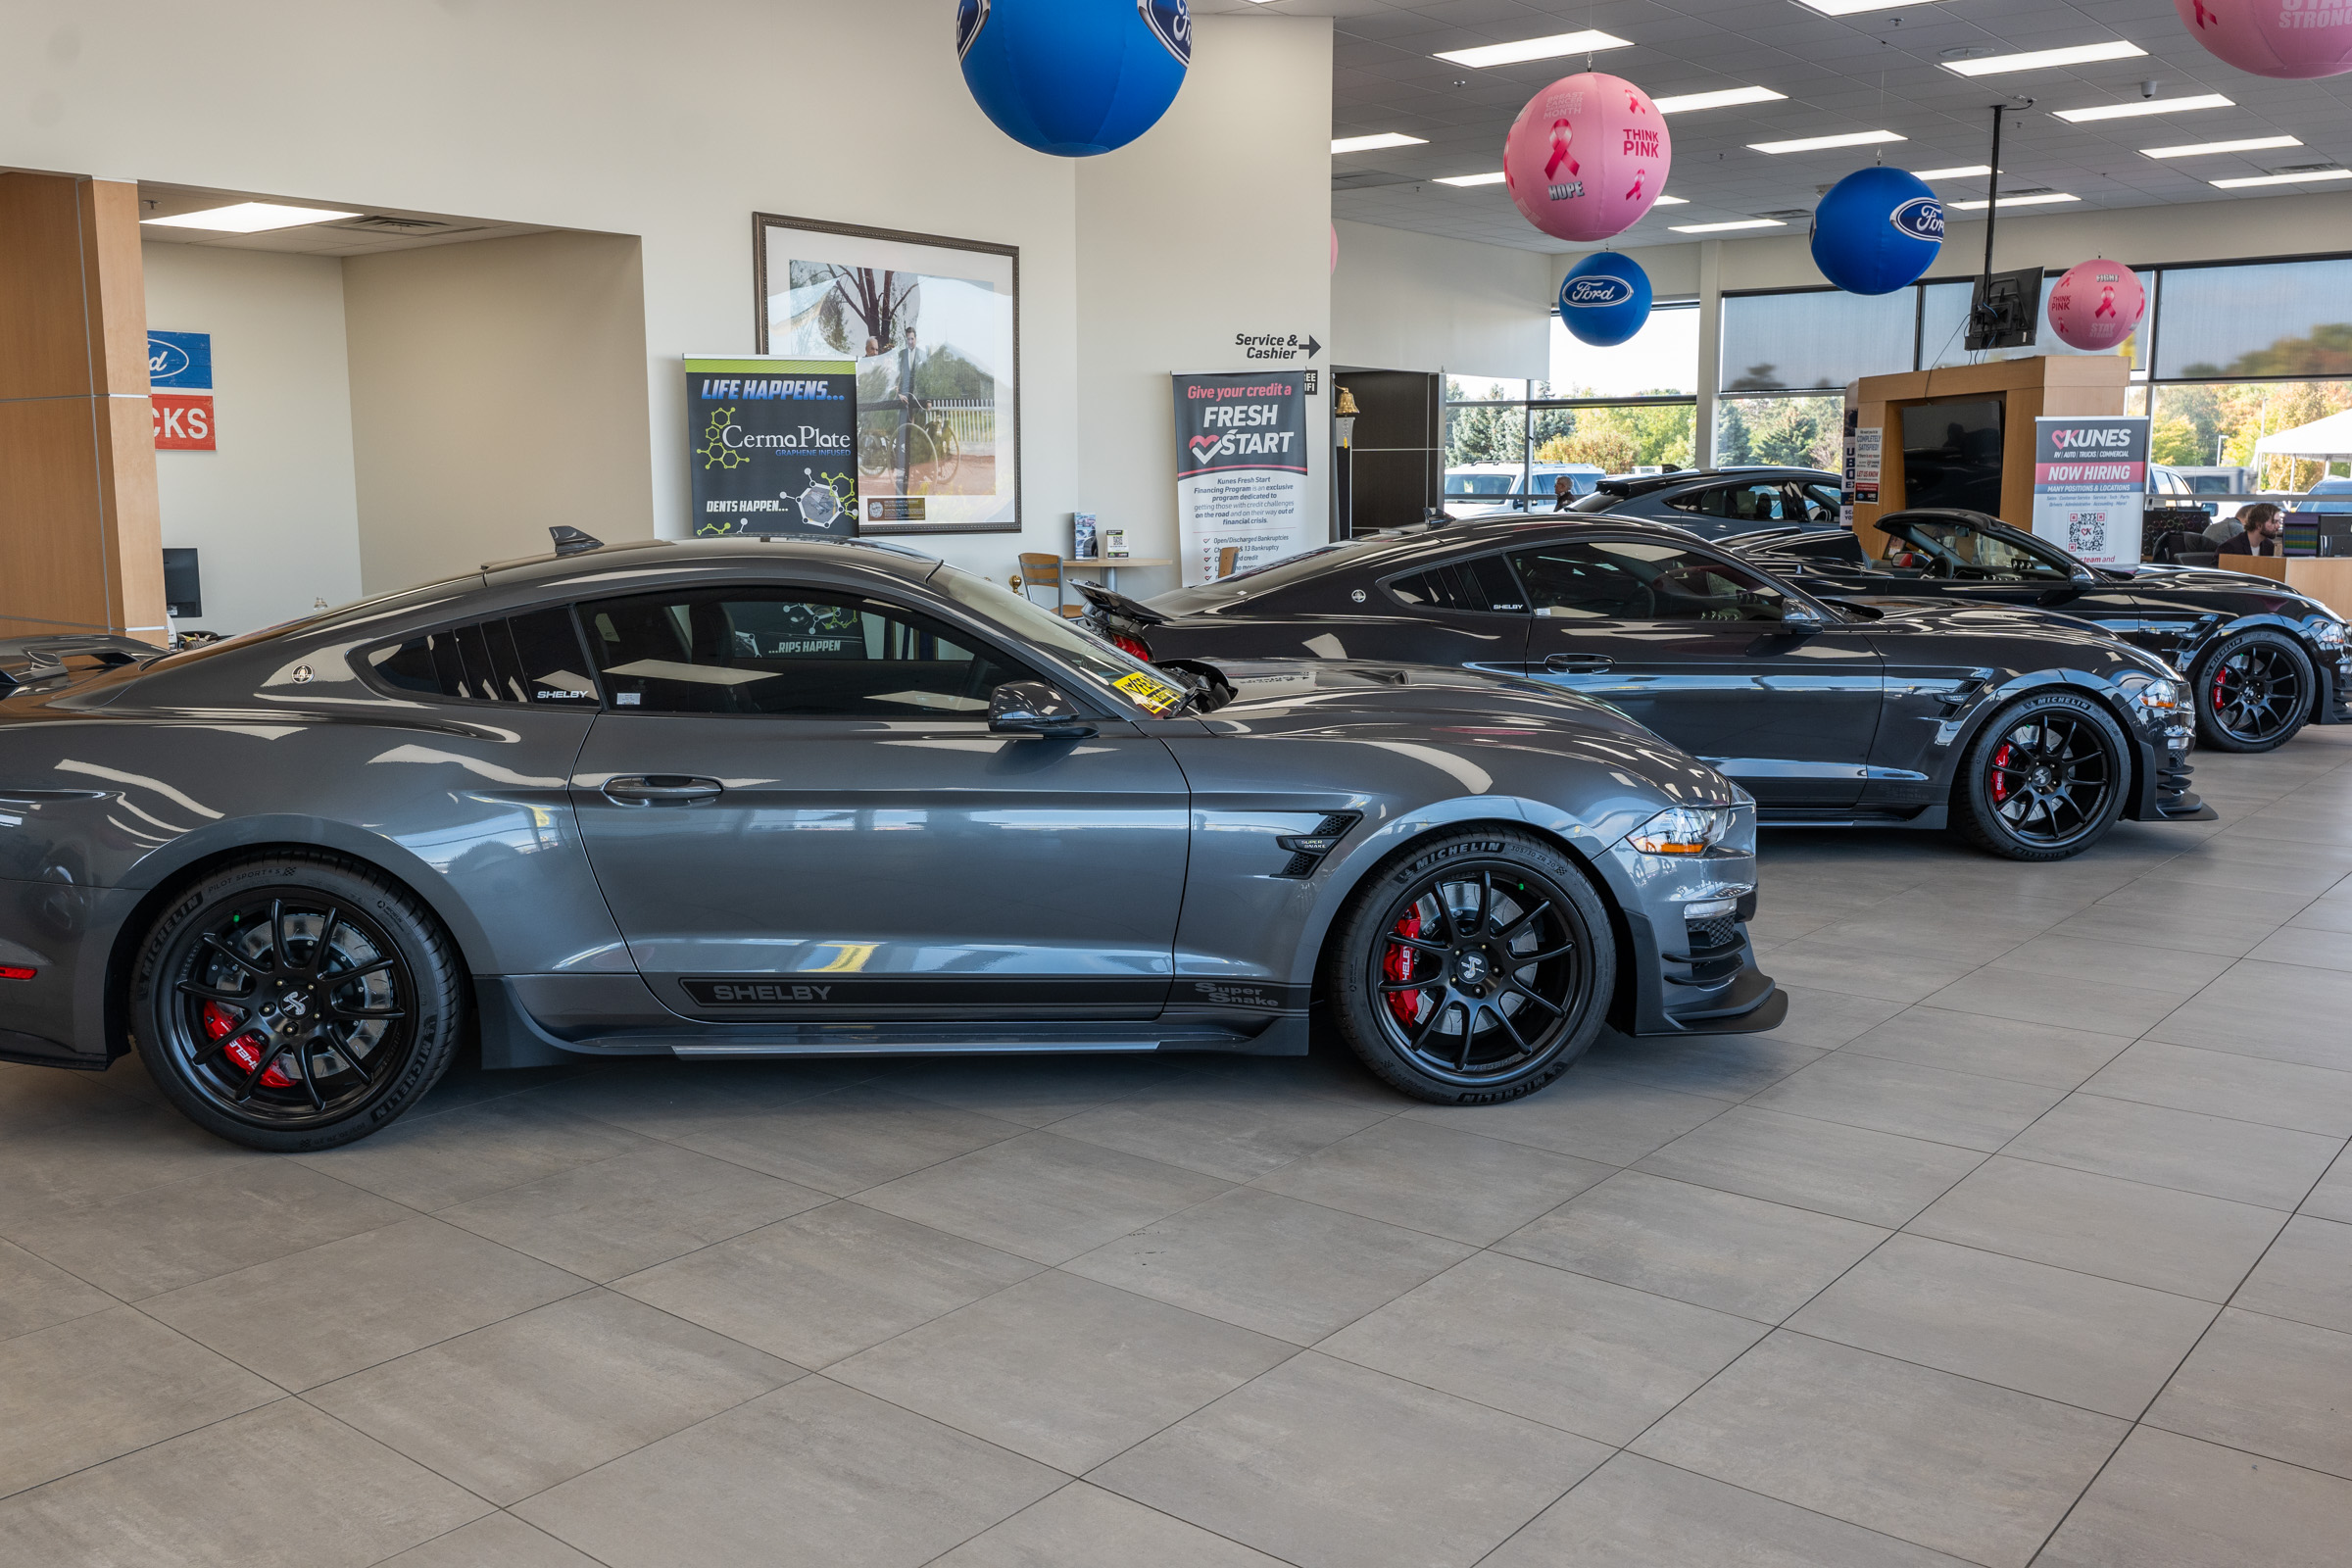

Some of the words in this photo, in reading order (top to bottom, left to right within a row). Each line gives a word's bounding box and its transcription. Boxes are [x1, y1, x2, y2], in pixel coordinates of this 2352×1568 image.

[1544, 108, 1582, 120] MONTH
[1623, 129, 1659, 143] THINK
[1623, 141, 1659, 159] PINK
[1548, 181, 1585, 201] HOPE
[1572, 281, 1615, 301] Ford
[2051, 302, 2071, 311] PINK
[2091, 322, 2116, 332] STAY
[1235, 333, 1285, 346] Service
[1287, 334, 1298, 347] &
[1247, 347, 1298, 360] Cashier
[1304, 372, 1316, 382] EE
[701, 379, 741, 400] LIFE
[742, 380, 845, 401] HAPPENS...
[1187, 385, 1215, 400] Give
[1216, 385, 1246, 402] your
[1247, 383, 1283, 398] credit
[1284, 385, 1292, 396] a
[1304, 382, 1315, 392] IFI
[1202, 404, 1279, 428] FRESH
[722, 425, 851, 448] CermaPlate
[1220, 428, 1295, 456] START
[2063, 428, 2132, 448] KUNES
[2048, 466, 2082, 481] NOW
[2083, 465, 2131, 480] HIRING
[706, 500, 738, 513] DENTS
[739, 500, 789, 513] HAPPEN...
[2102, 555, 2116, 564] and
[803, 640, 841, 653] HAPPEN
[2211, 638, 2240, 667] MICHELIN
[537, 690, 588, 699] SHELBY
[2037, 697, 2088, 709] MICHELIN
[1415, 842, 1500, 870] MICHELIN
[1510, 845, 1536, 858] 305/30
[1537, 854, 1546, 863] ZR
[1547, 858, 1556, 868] 20
[208, 878, 232, 893] PILOT
[235, 870, 266, 881] SPORT
[142, 894, 200, 977] MICHELIN
[713, 985, 832, 1001] SHELBY
[1195, 982, 1263, 996] Super
[1208, 992, 1279, 1006] Snake
[375, 1038, 432, 1118] MICHELIN
[1463, 1073, 1546, 1103] MICHELIN
